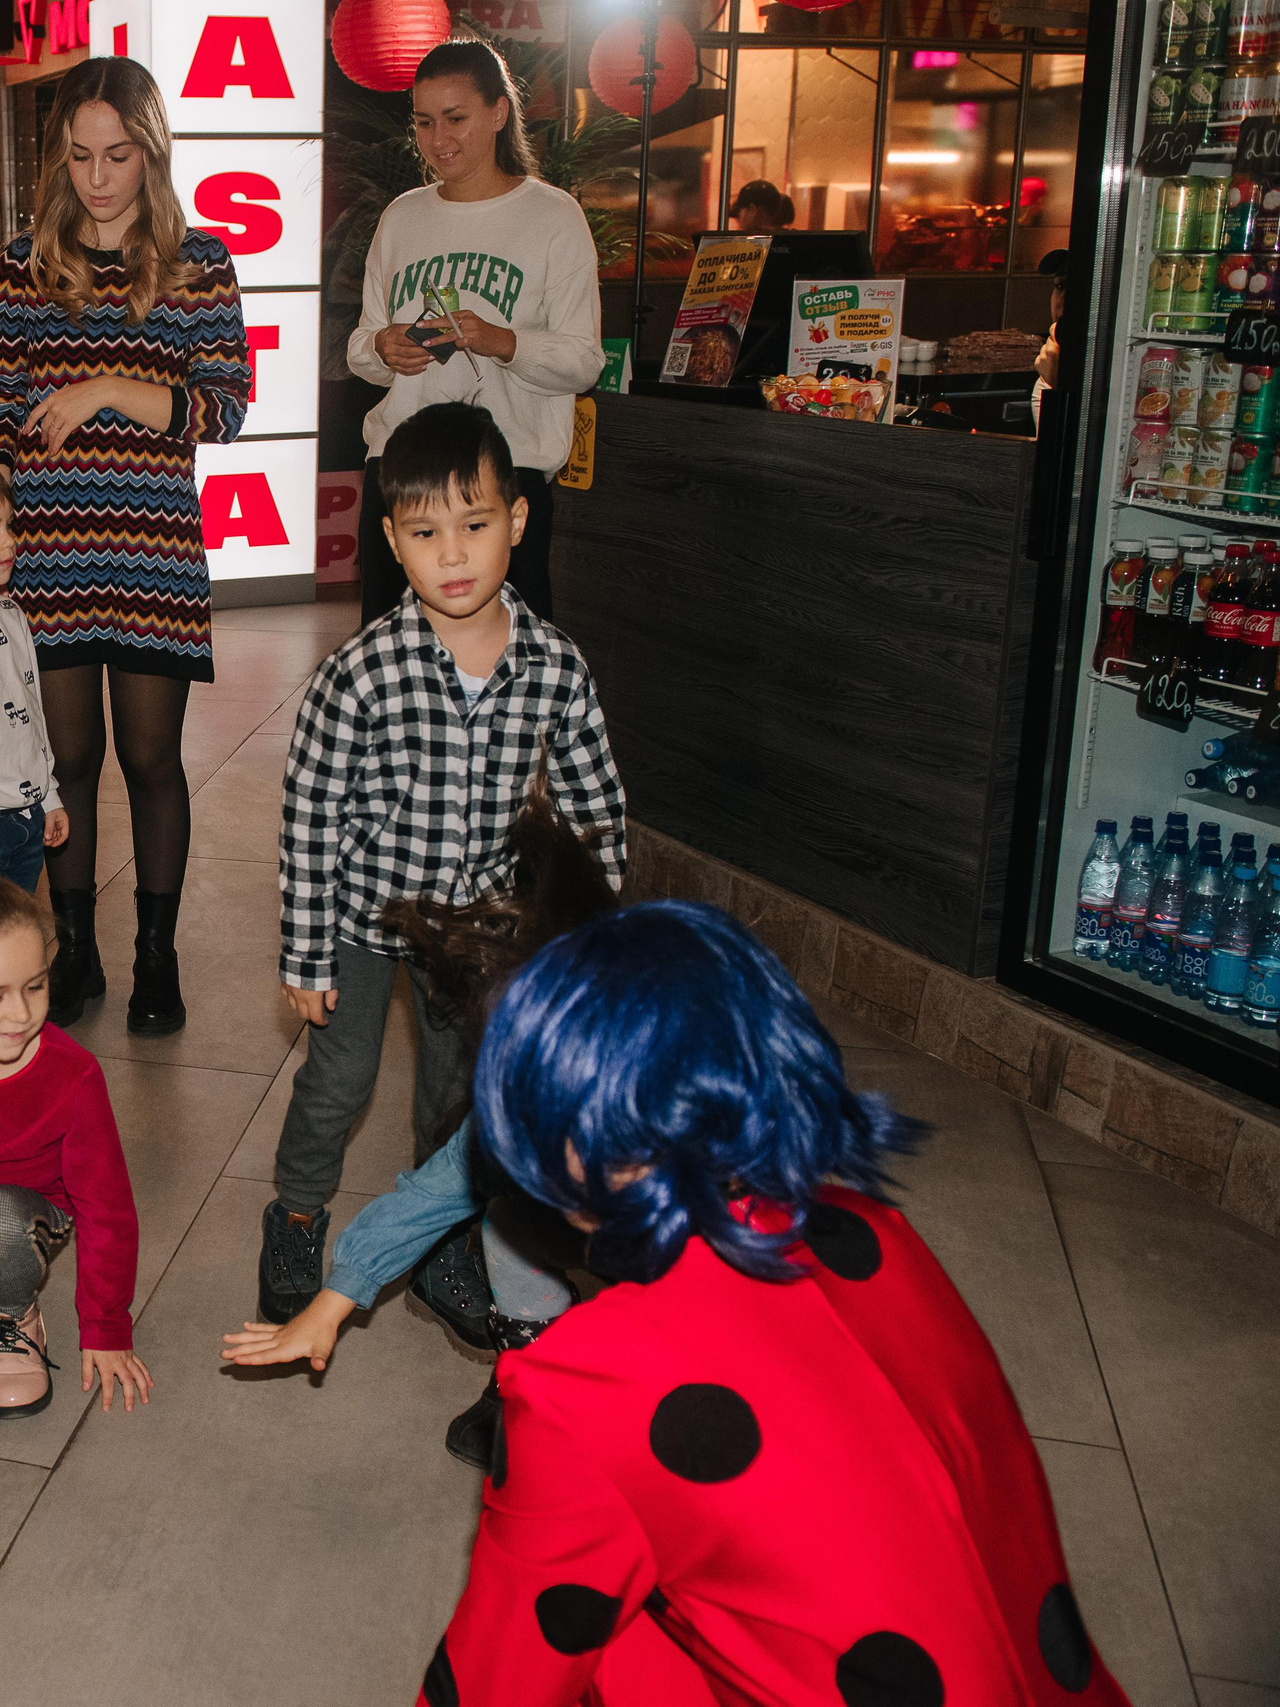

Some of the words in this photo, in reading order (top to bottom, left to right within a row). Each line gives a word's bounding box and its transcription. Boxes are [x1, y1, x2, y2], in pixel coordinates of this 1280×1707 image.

[697, 250, 762, 269] ОПЛАЧИВАЙ
[697, 271, 716, 287] ДО
[689, 287, 715, 296] ЗАКАЗА
[716, 282, 755, 293] БОНУСАМИ
[804, 290, 853, 306] ОСТАВЬ
[805, 301, 848, 316] ОТЗЫВ
[840, 321, 880, 329] ЛИМОНАД
[1205, 605, 1244, 626] Coca-Co
[1183, 964, 1208, 977] aq
